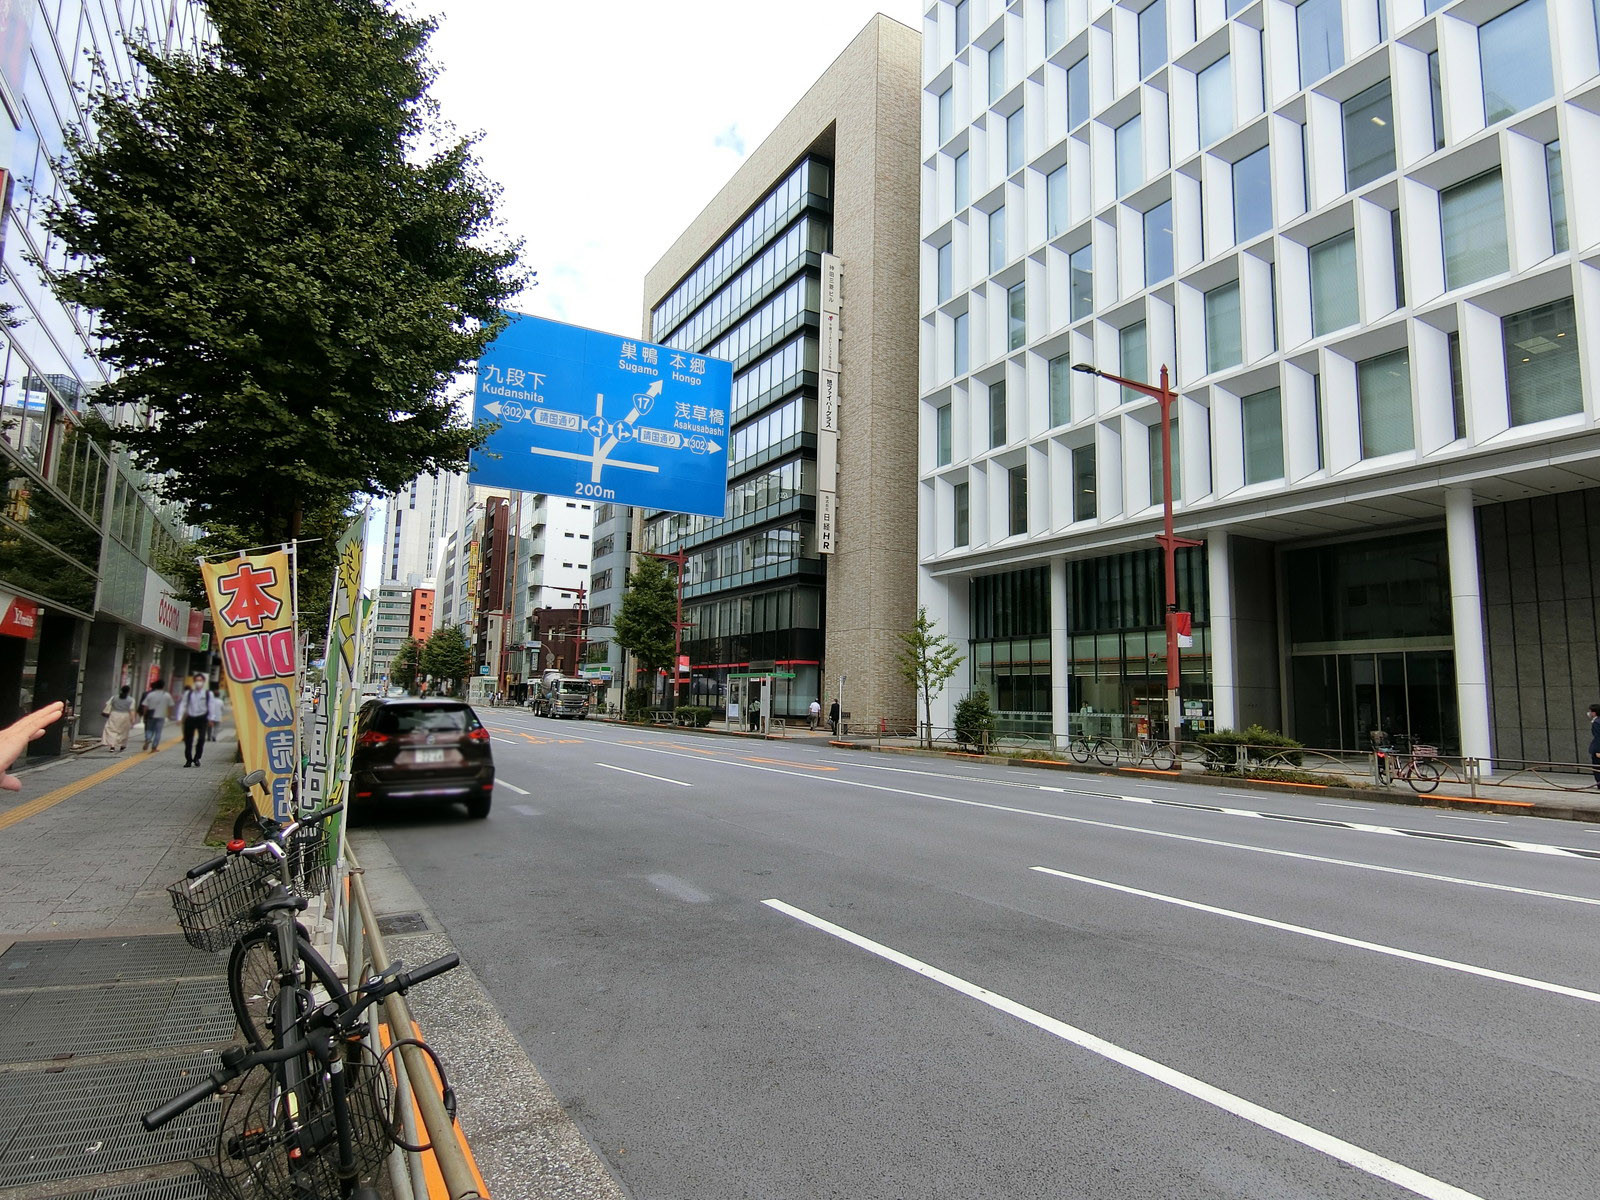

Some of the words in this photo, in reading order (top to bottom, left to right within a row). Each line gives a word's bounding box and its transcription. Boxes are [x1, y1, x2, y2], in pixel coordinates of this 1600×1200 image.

[620, 341, 658, 366] 巣鴨
[669, 353, 706, 376] 本郷
[484, 364, 547, 390] 九段下
[618, 359, 659, 377] Sugamo
[672, 371, 702, 386] Hongo
[482, 383, 544, 403] Kudanshita
[504, 406, 522, 418] 302
[637, 397, 650, 410] 17
[674, 401, 725, 426] 浅草橋
[673, 420, 725, 437] Asakusabashi
[691, 439, 706, 449] 302
[575, 482, 615, 499] 200m
